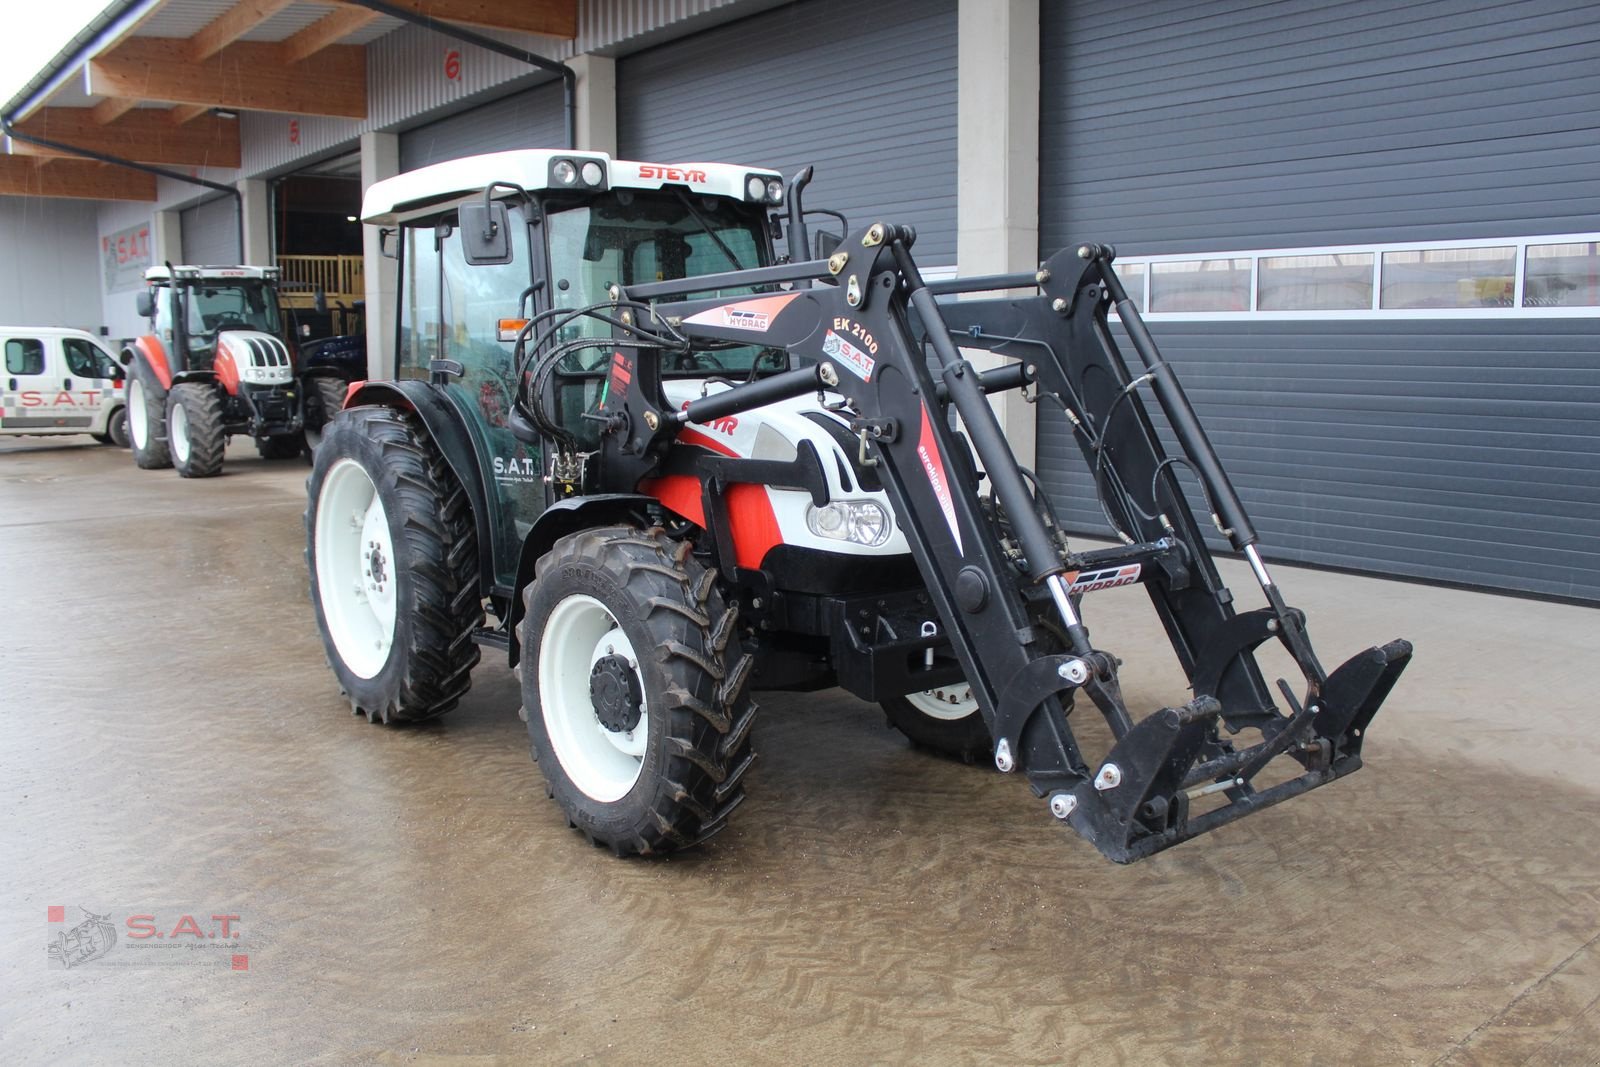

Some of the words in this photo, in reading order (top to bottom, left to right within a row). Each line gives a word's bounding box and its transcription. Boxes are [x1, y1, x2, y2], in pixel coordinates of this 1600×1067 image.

[639, 165, 706, 184] STEYR
[729, 317, 767, 329] HYDRAC
[833, 318, 850, 331] EK
[851, 323, 878, 354] 2100
[841, 343, 873, 372] S.A.T.
[21, 391, 101, 406] S.A.T.
[493, 456, 534, 475] S.A.T.
[919, 446, 942, 492] eurokipp
[1069, 577, 1135, 595] HYDRAC
